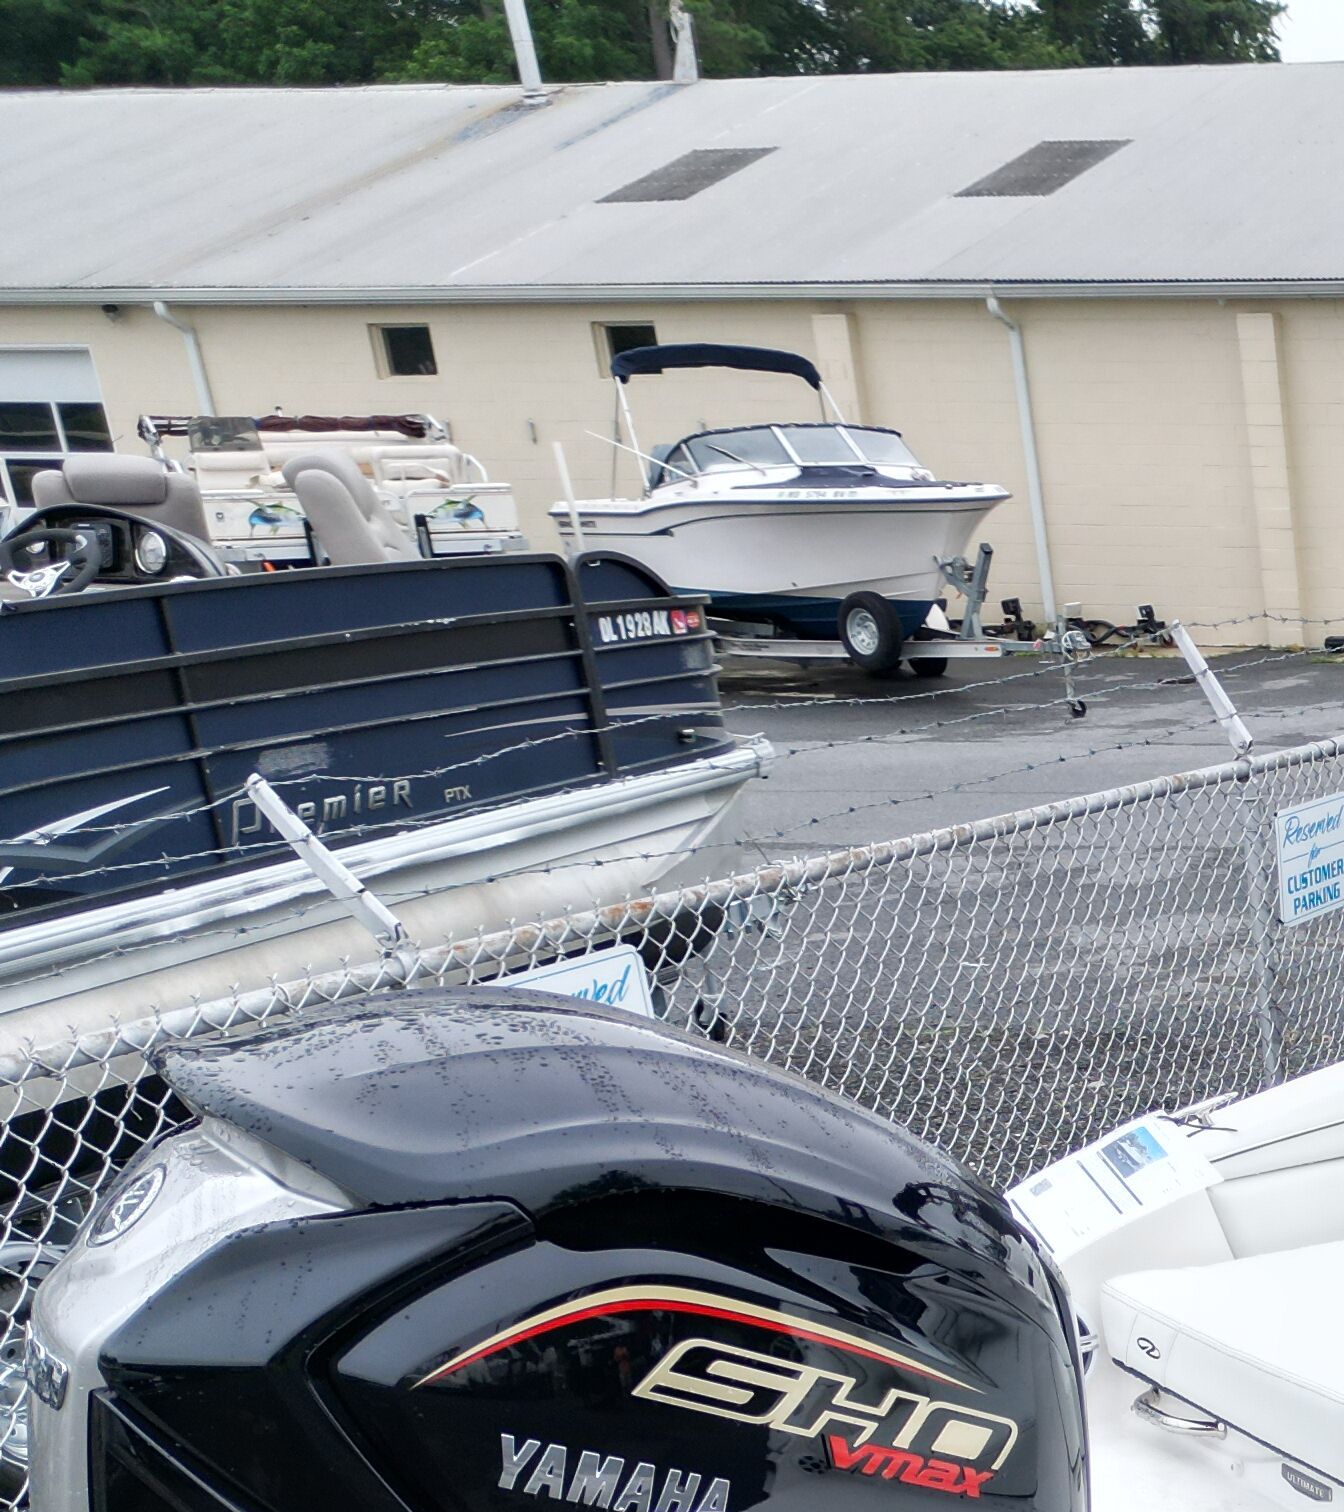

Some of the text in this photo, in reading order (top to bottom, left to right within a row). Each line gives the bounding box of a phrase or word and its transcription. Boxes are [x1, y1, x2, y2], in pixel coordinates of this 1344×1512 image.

[616, 611, 653, 640] 1928
[444, 785, 474, 803] PTX
[1283, 805, 1344, 848] Reserved
[1308, 843, 1321, 868] for
[1287, 858, 1344, 895] CUSTOMER
[1293, 882, 1340, 915] PARKING
[631, 1337, 1018, 1470] SHO
[1286, 1471, 1326, 1498] ULTIMATE
